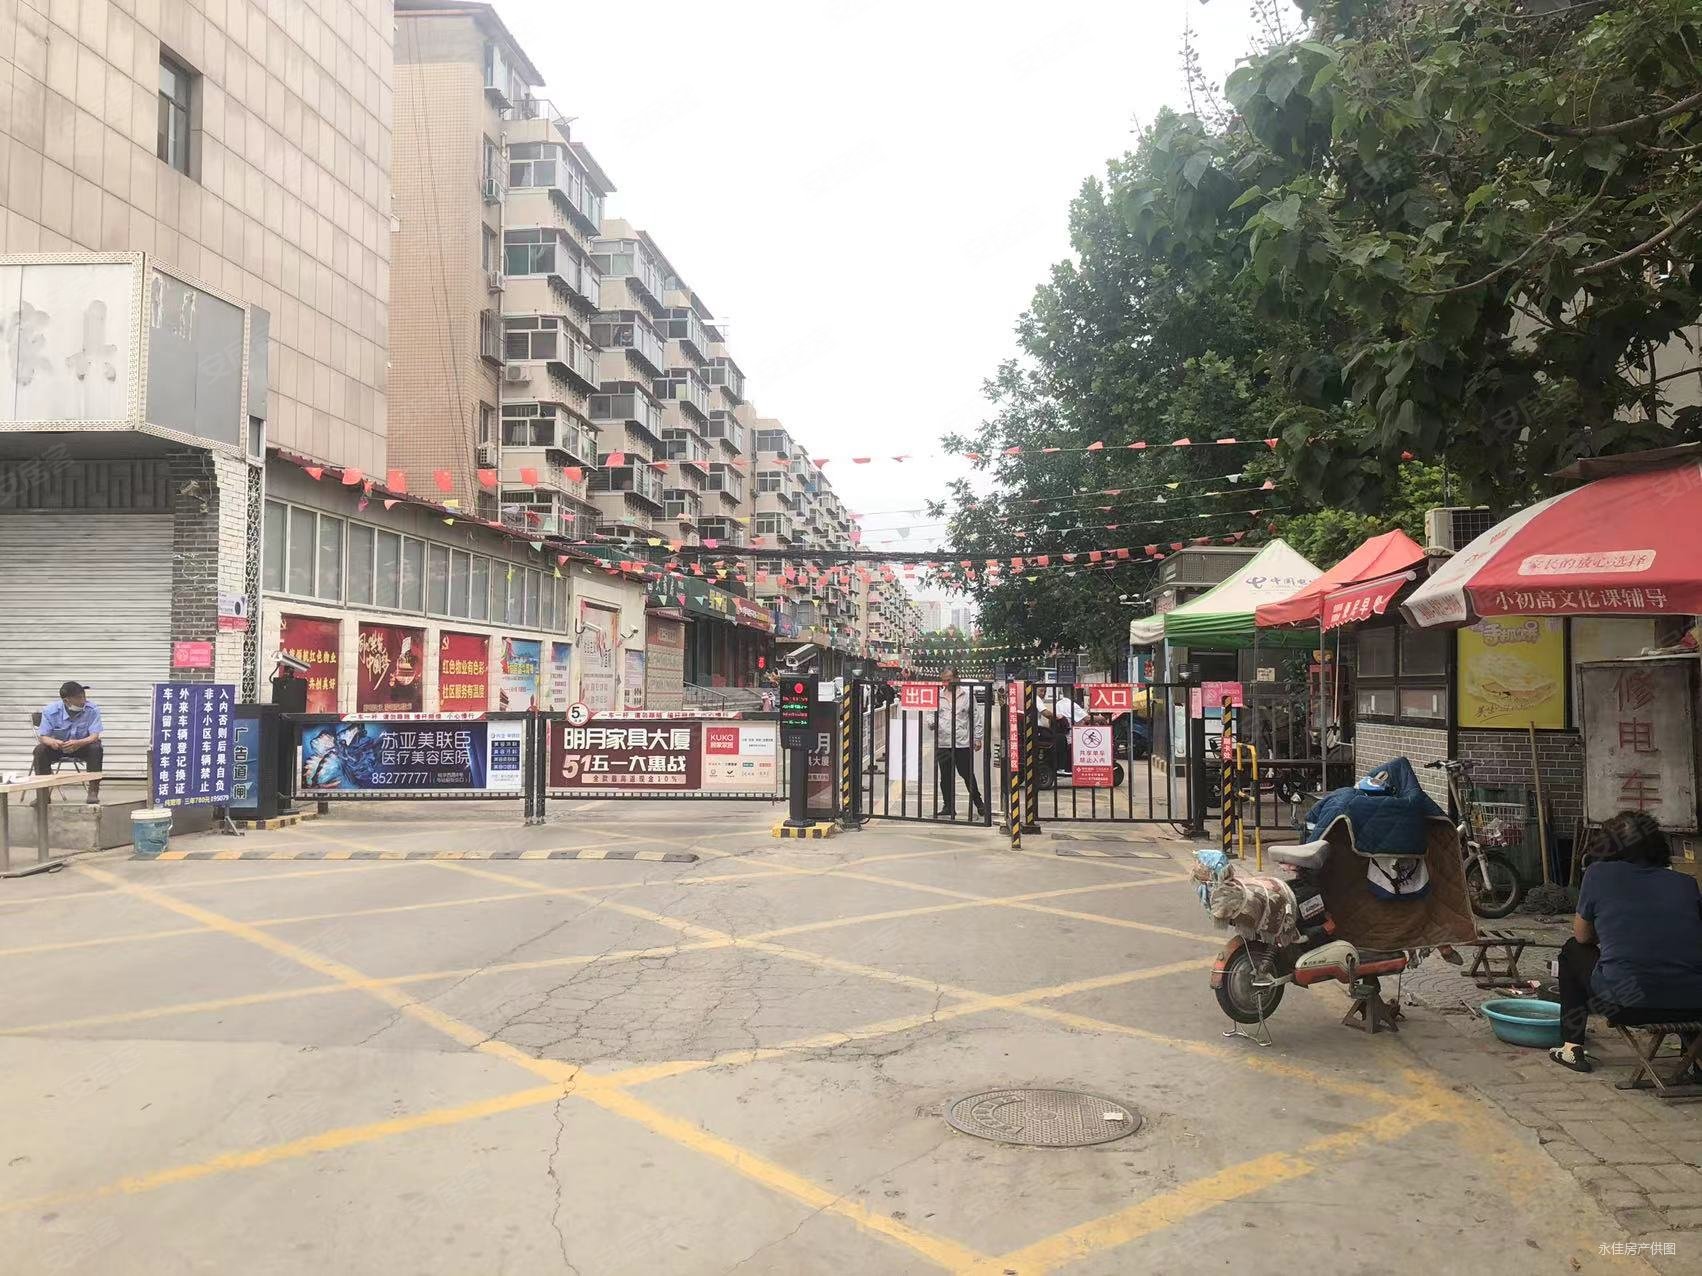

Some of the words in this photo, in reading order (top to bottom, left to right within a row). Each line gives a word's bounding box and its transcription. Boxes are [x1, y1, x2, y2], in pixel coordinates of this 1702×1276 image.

[1528, 554, 1648, 571] 家长的放心选择
[1270, 577, 1312, 586] 中国电
[1495, 588, 1667, 611] 小初高文化课辅导
[906, 687, 934, 705] 出口
[1094, 689, 1127, 706] 入口
[571, 706, 580, 719] 5
[158, 687, 173, 796] 车内留下挪车电话
[175, 687, 190, 795] 外来车辆登记换证
[199, 687, 214, 793] 非本小区车辆禁止
[215, 688, 229, 792] 入内否则后果自负
[381, 731, 471, 750] 苏亚美联臣
[563, 728, 691, 751] 明月家具大厦
[1614, 670, 1664, 812] 修电车
[233, 727, 248, 800] 广告道闸
[381, 750, 471, 767] 医疗美容医院
[371, 772, 428, 784] 85277777
